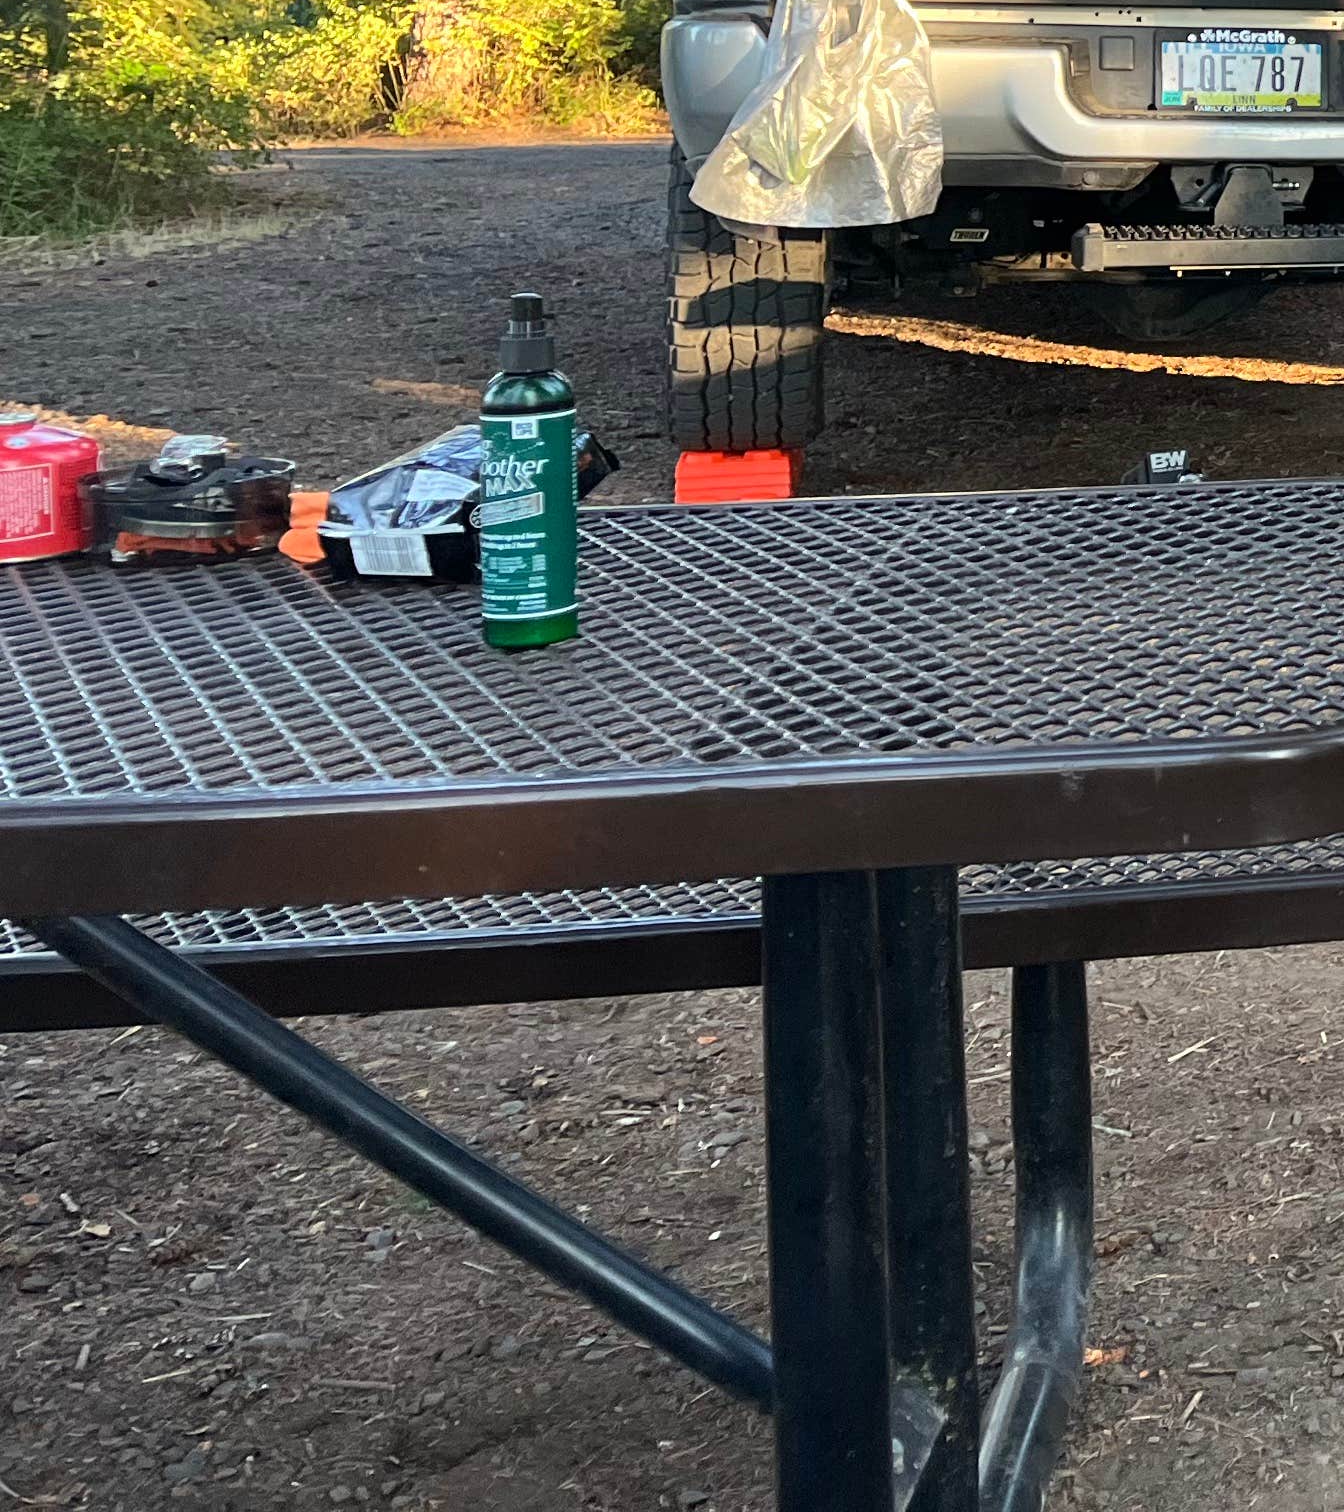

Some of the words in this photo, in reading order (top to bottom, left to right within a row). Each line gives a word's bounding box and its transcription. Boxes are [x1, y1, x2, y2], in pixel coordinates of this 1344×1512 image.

[1215, 29, 1286, 44] McGrath
[1178, 55, 1237, 92] LQE
[1251, 55, 1305, 93] 787
[485, 474, 537, 498] MAX
